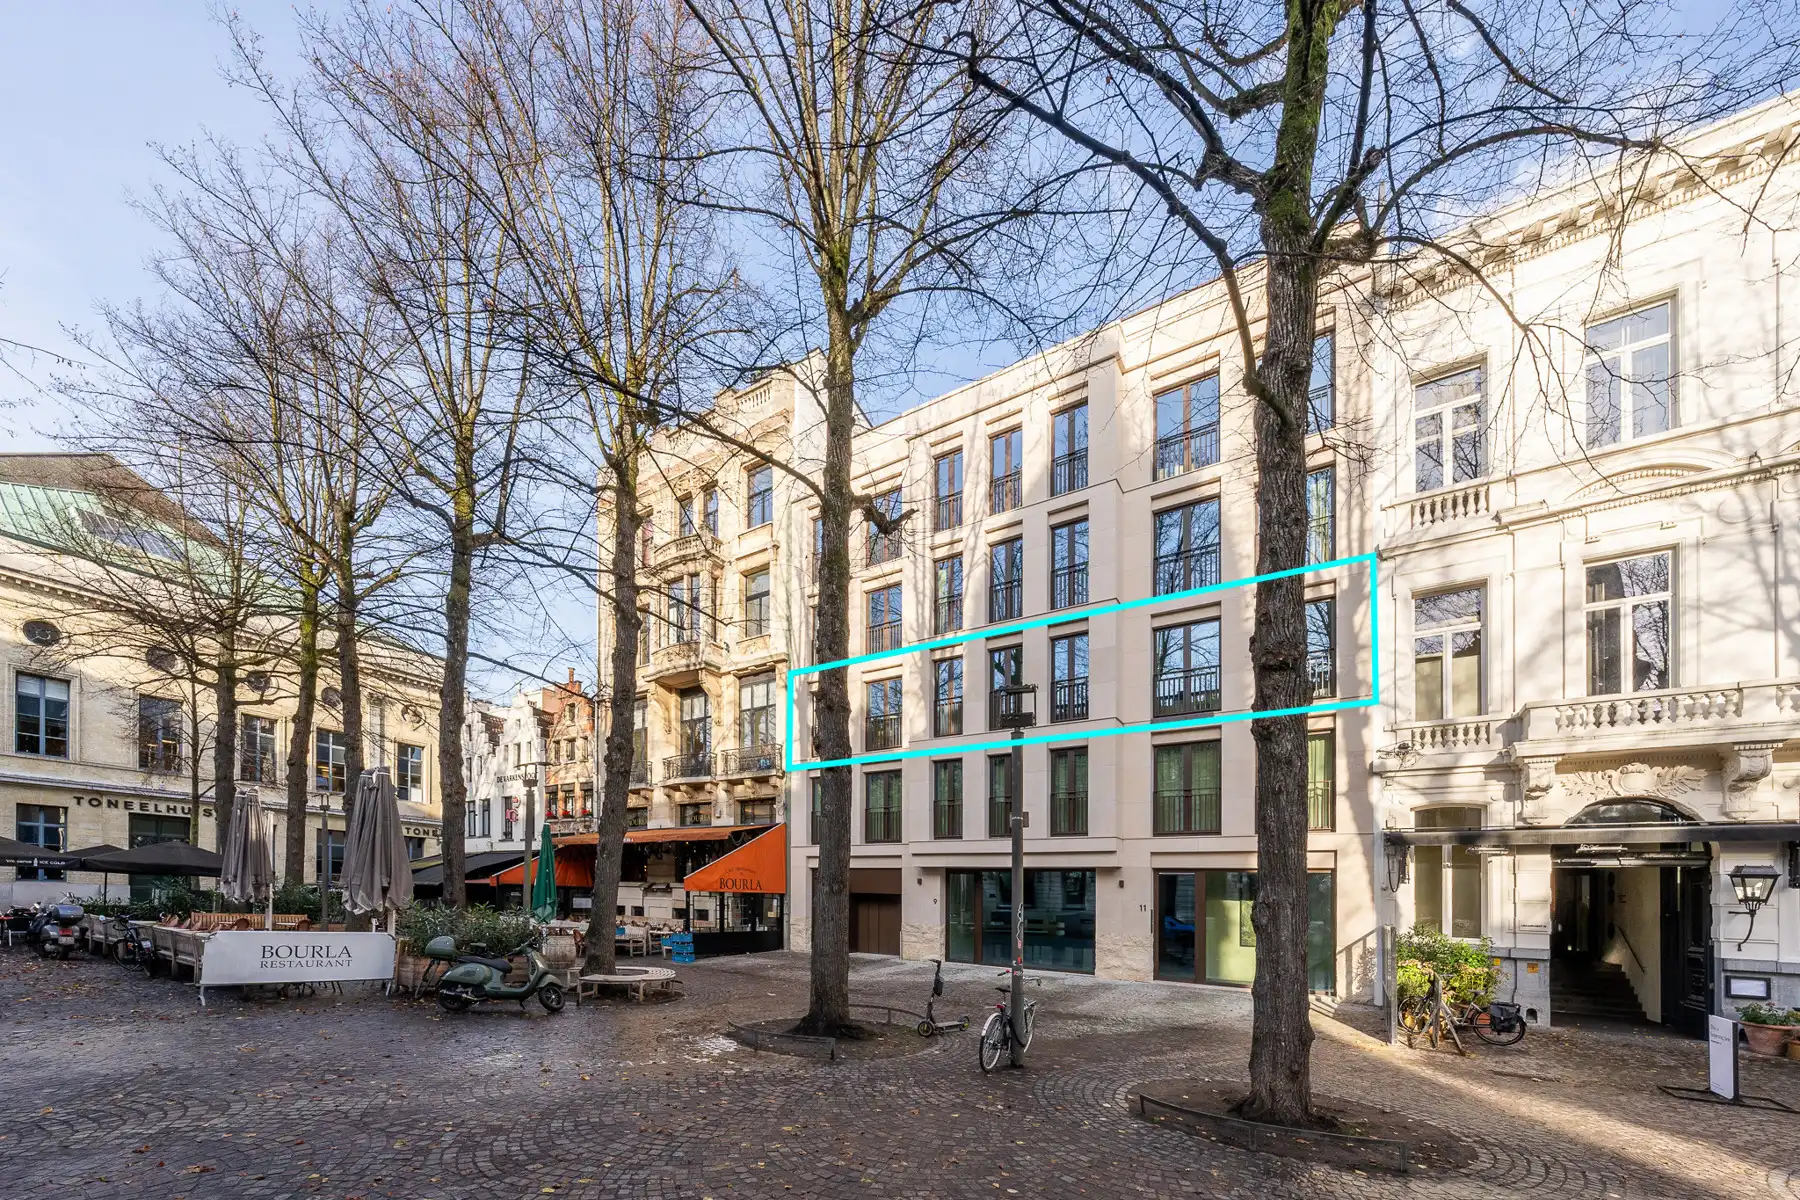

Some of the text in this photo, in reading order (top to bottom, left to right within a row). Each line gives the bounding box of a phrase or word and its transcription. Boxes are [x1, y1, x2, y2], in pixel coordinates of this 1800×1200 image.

[73, 796, 213, 817] TONEELHUS
[405, 827, 438, 837] TONE
[720, 878, 763, 890] BOURLA
[1139, 904, 1147, 912] 11
[261, 945, 353, 959] BOURLA
[260, 960, 353, 969] RESTAURANT
